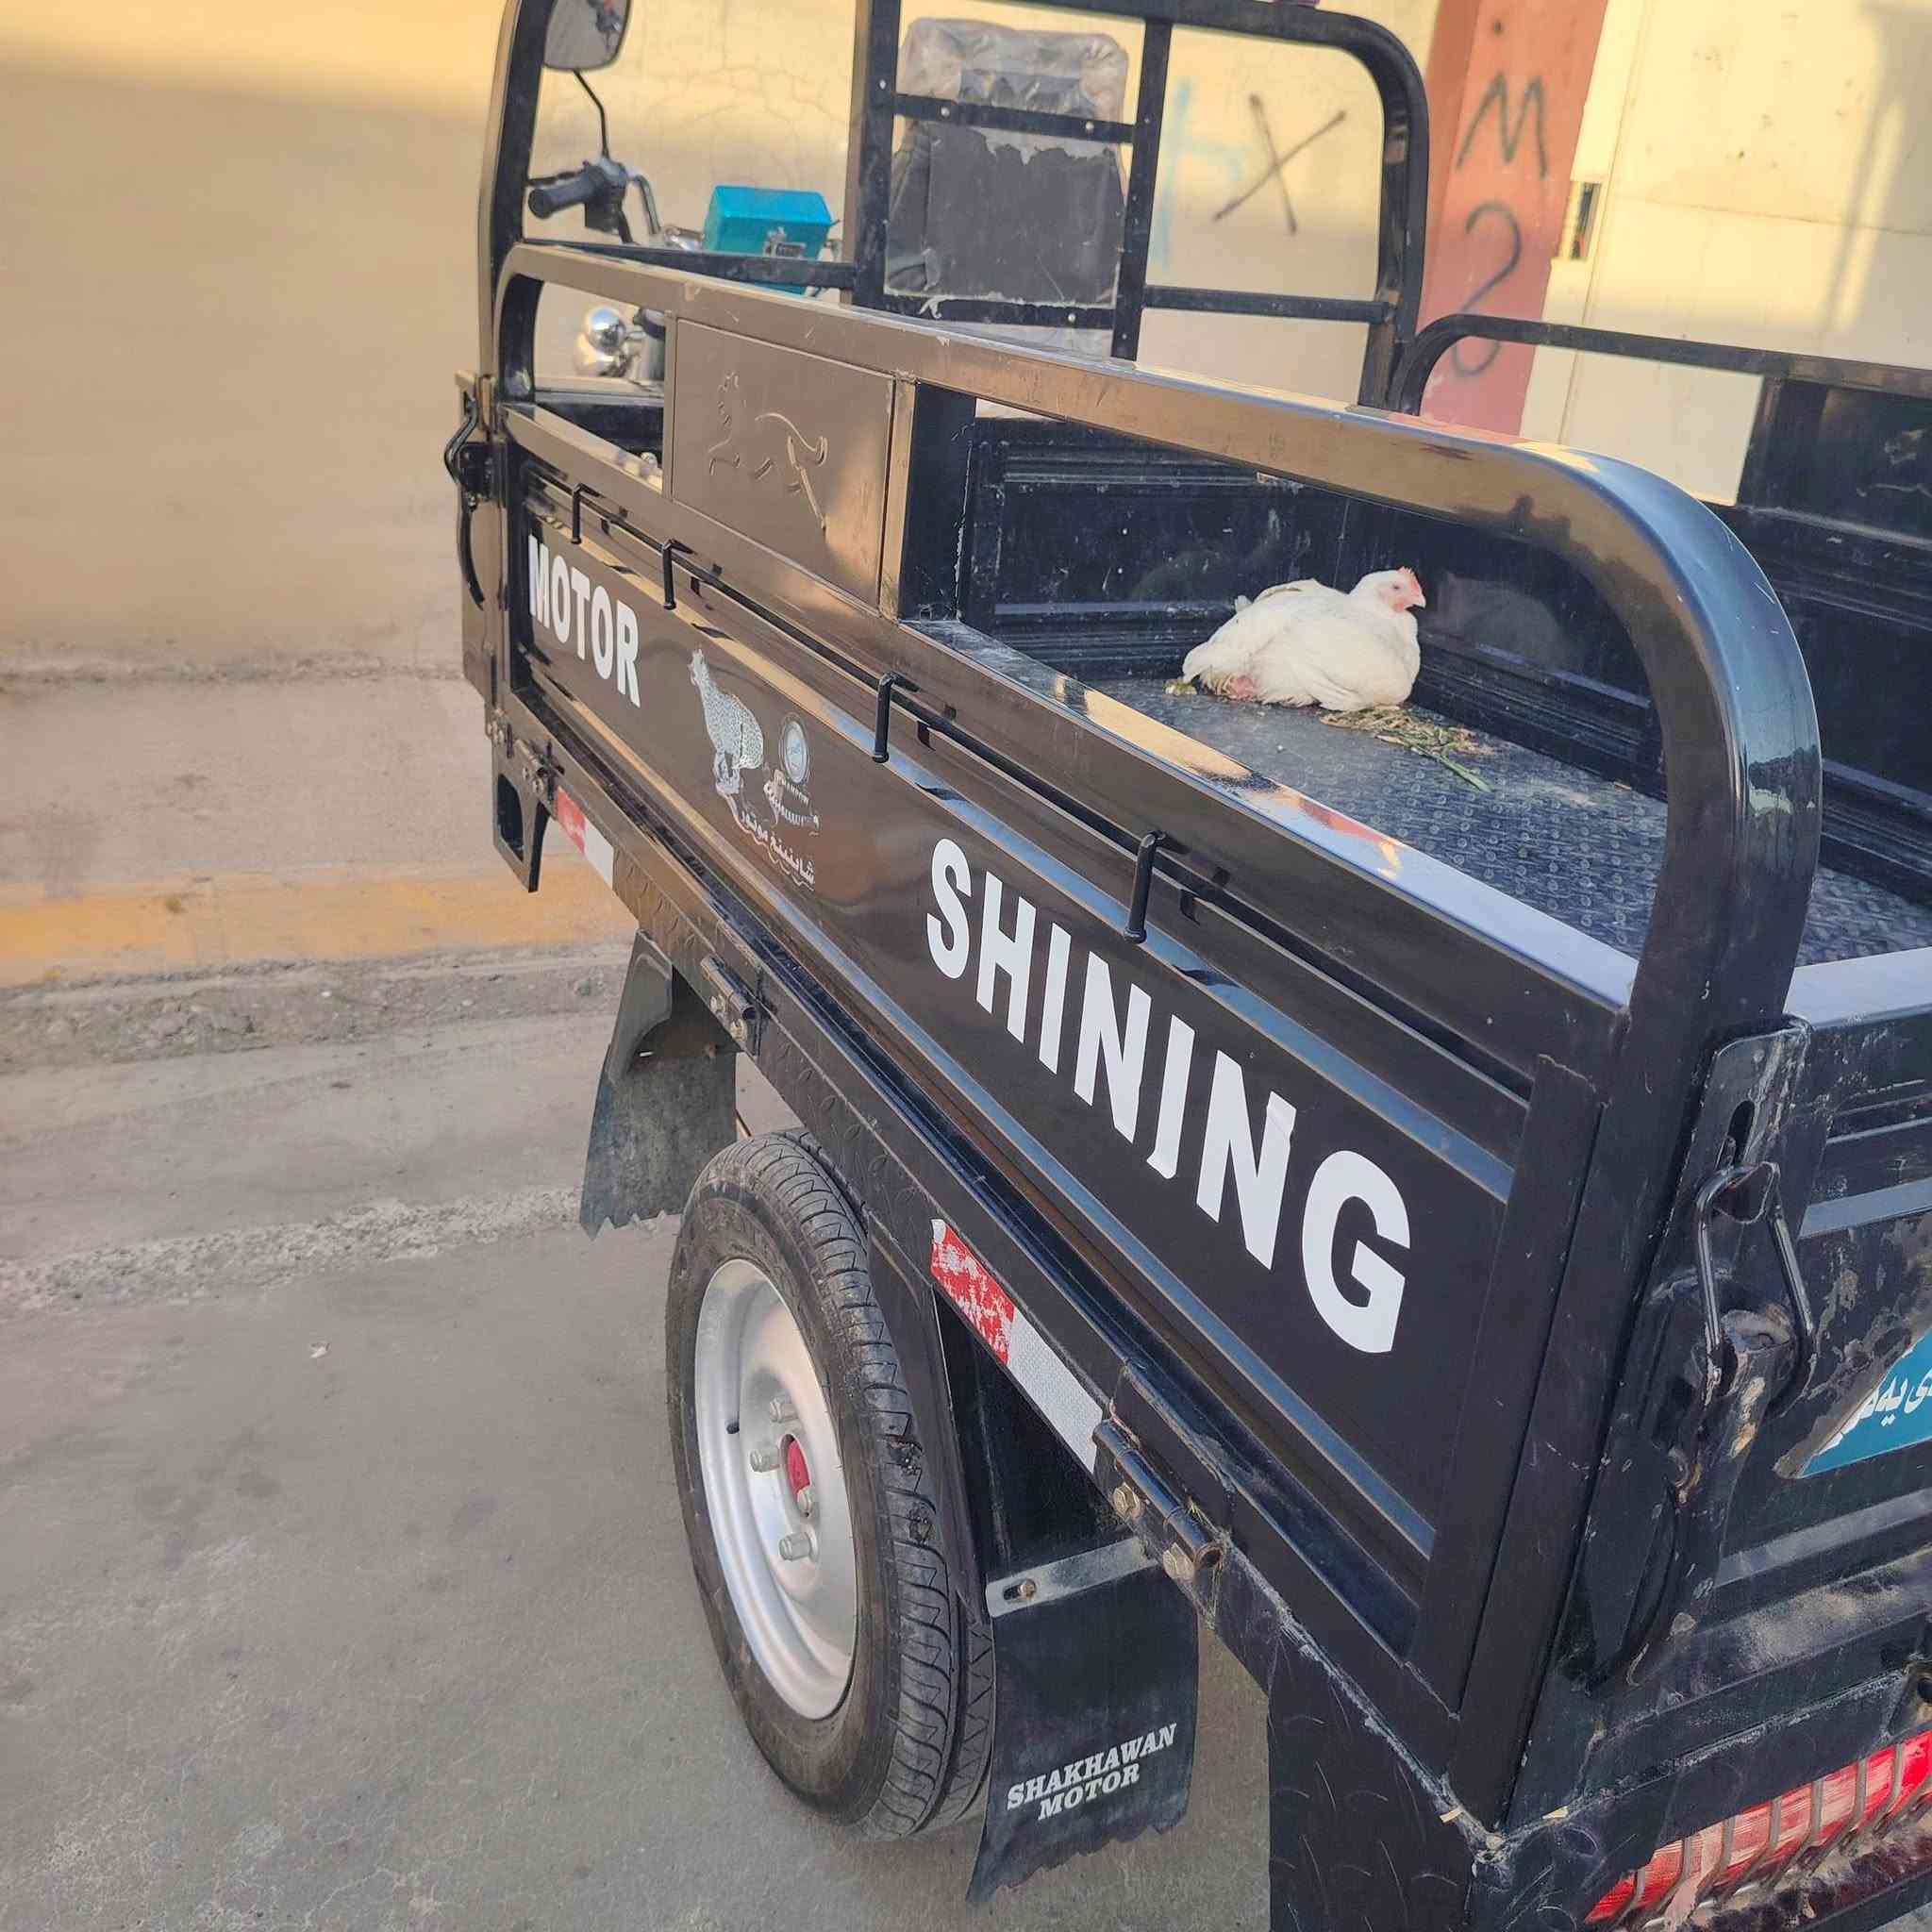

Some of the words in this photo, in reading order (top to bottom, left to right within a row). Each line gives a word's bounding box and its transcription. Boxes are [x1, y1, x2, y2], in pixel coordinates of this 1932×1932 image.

[527, 534, 641, 708] MOTOR
[925, 837, 1412, 1355] SHINING
[1006, 1723, 1177, 1810] SHAKHAWAN
[1037, 1762, 1141, 1822] MOTOR
